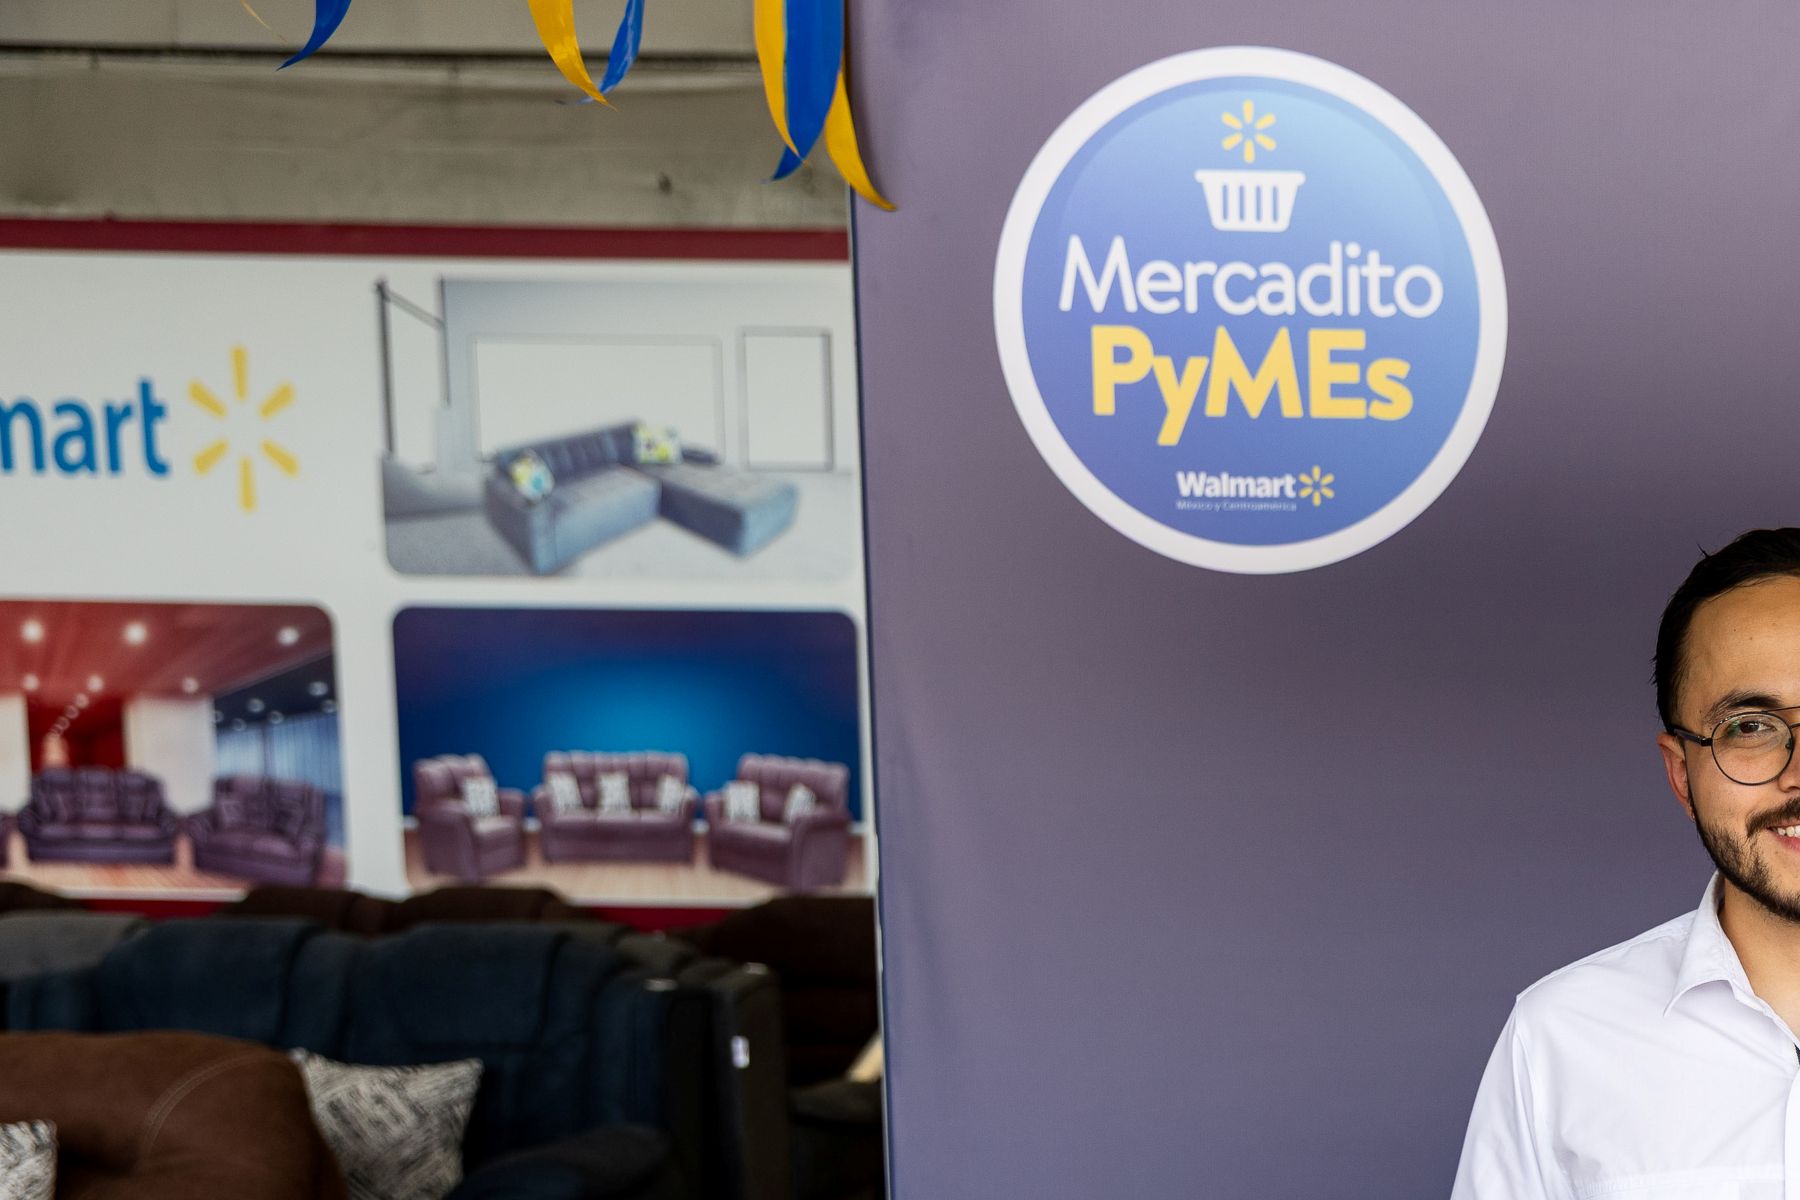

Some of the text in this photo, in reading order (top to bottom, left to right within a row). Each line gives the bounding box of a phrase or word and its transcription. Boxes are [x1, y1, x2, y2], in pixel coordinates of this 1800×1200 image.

[1059, 234, 1443, 318] Mercadito
[1091, 324, 1414, 446] PyMEs
[1176, 470, 1296, 498] Walmart
